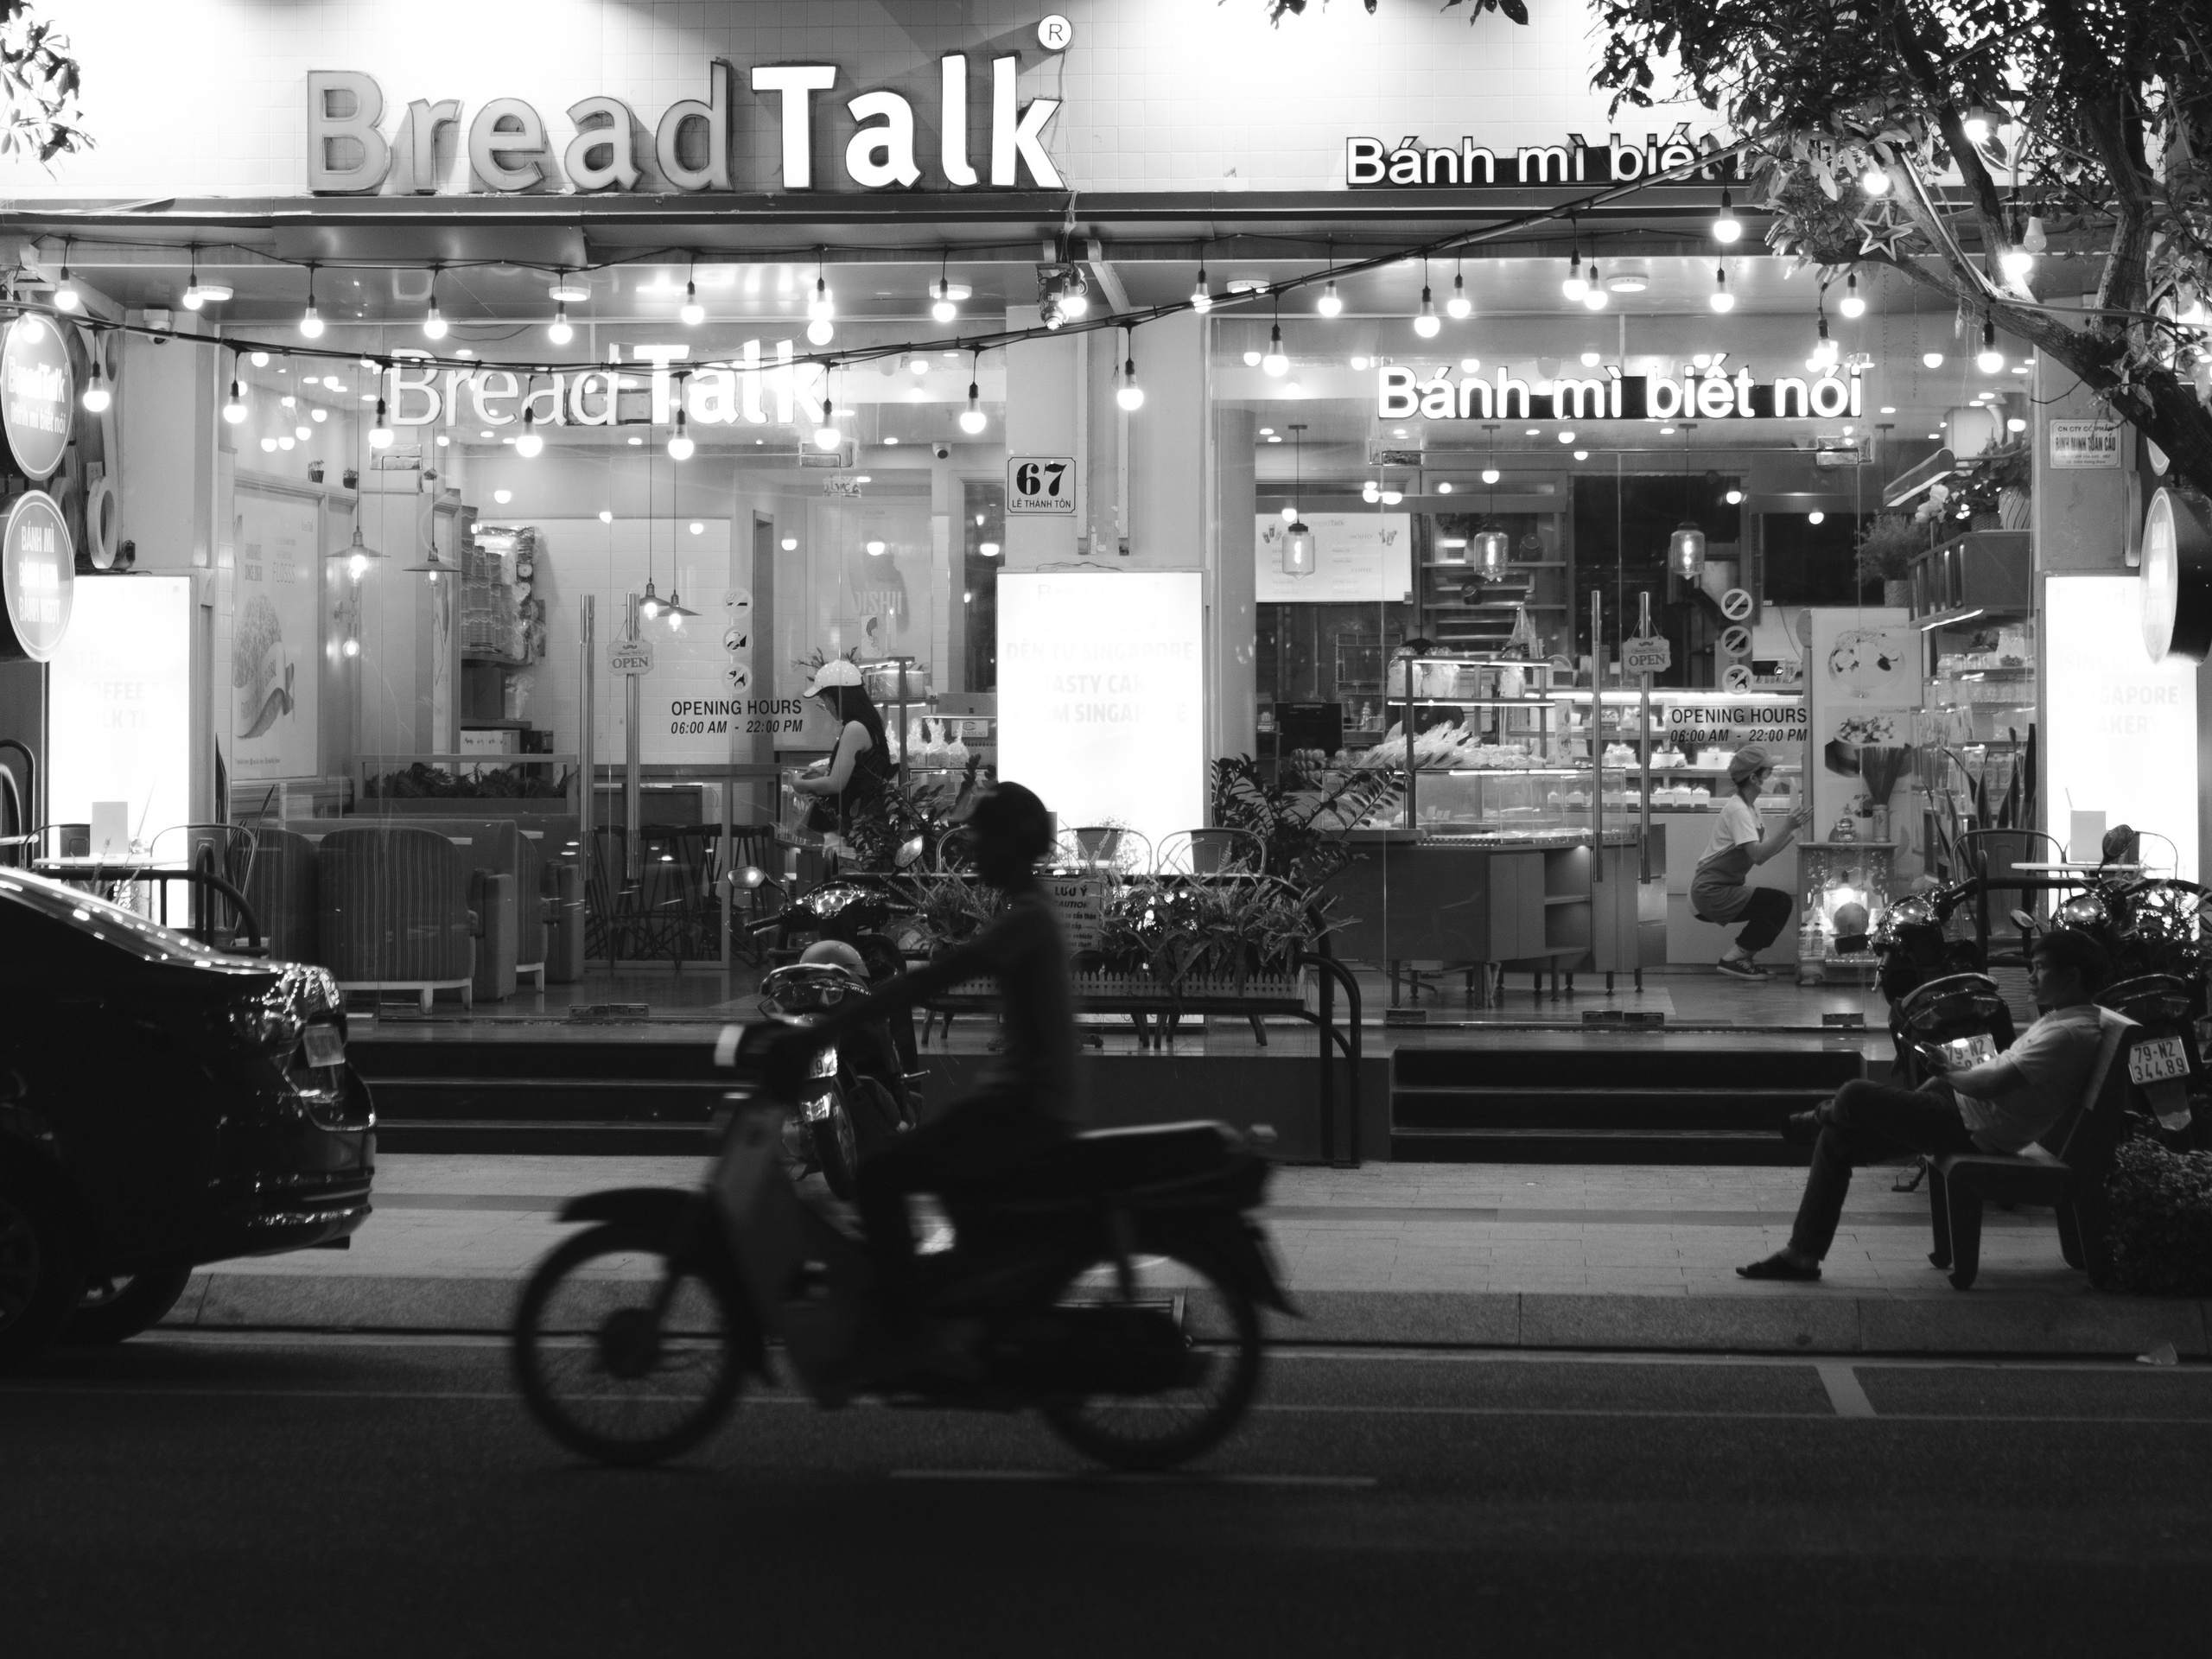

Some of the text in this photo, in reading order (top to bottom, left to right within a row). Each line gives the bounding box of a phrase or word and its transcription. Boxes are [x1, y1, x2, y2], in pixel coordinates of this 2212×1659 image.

[1347, 136, 1495, 185] Bánh
[1518, 133, 1584, 185] mì
[1379, 353, 1862, 420] Bánh mì biết nói
[1016, 463, 1067, 496] 67
[1012, 498, 1022, 508] LÊ
[1054, 498, 1071, 508] TÔN
[21, 520, 54, 553] BÁNH MÌ
[612, 657, 648, 669] OPEN
[1629, 654, 1666, 666] OPEN
[82, 682, 144, 700] OFFEE
[1107, 674, 1149, 694] CAK
[2064, 685, 2179, 705] SGAPORE
[671, 699, 802, 715] OPENING HOURS
[1075, 703, 1186, 722] SINGAPE
[1671, 709, 1807, 723] OPENING HOURS
[129, 710, 154, 728] TE
[671, 721, 703, 734] 06:00
[708, 721, 727, 734] AM
[746, 720, 779, 734] 22:00
[784, 720, 803, 733] PM
[2089, 715, 2160, 734] AKERY
[1670, 729, 1705, 742] 06:00
[1708, 729, 1729, 742] AM
[1749, 729, 1783, 742] 22:00
[1787, 728, 1808, 741] PM
[2134, 1041, 2176, 1063] 79-N2
[2134, 1058, 2185, 1081] 344.89
